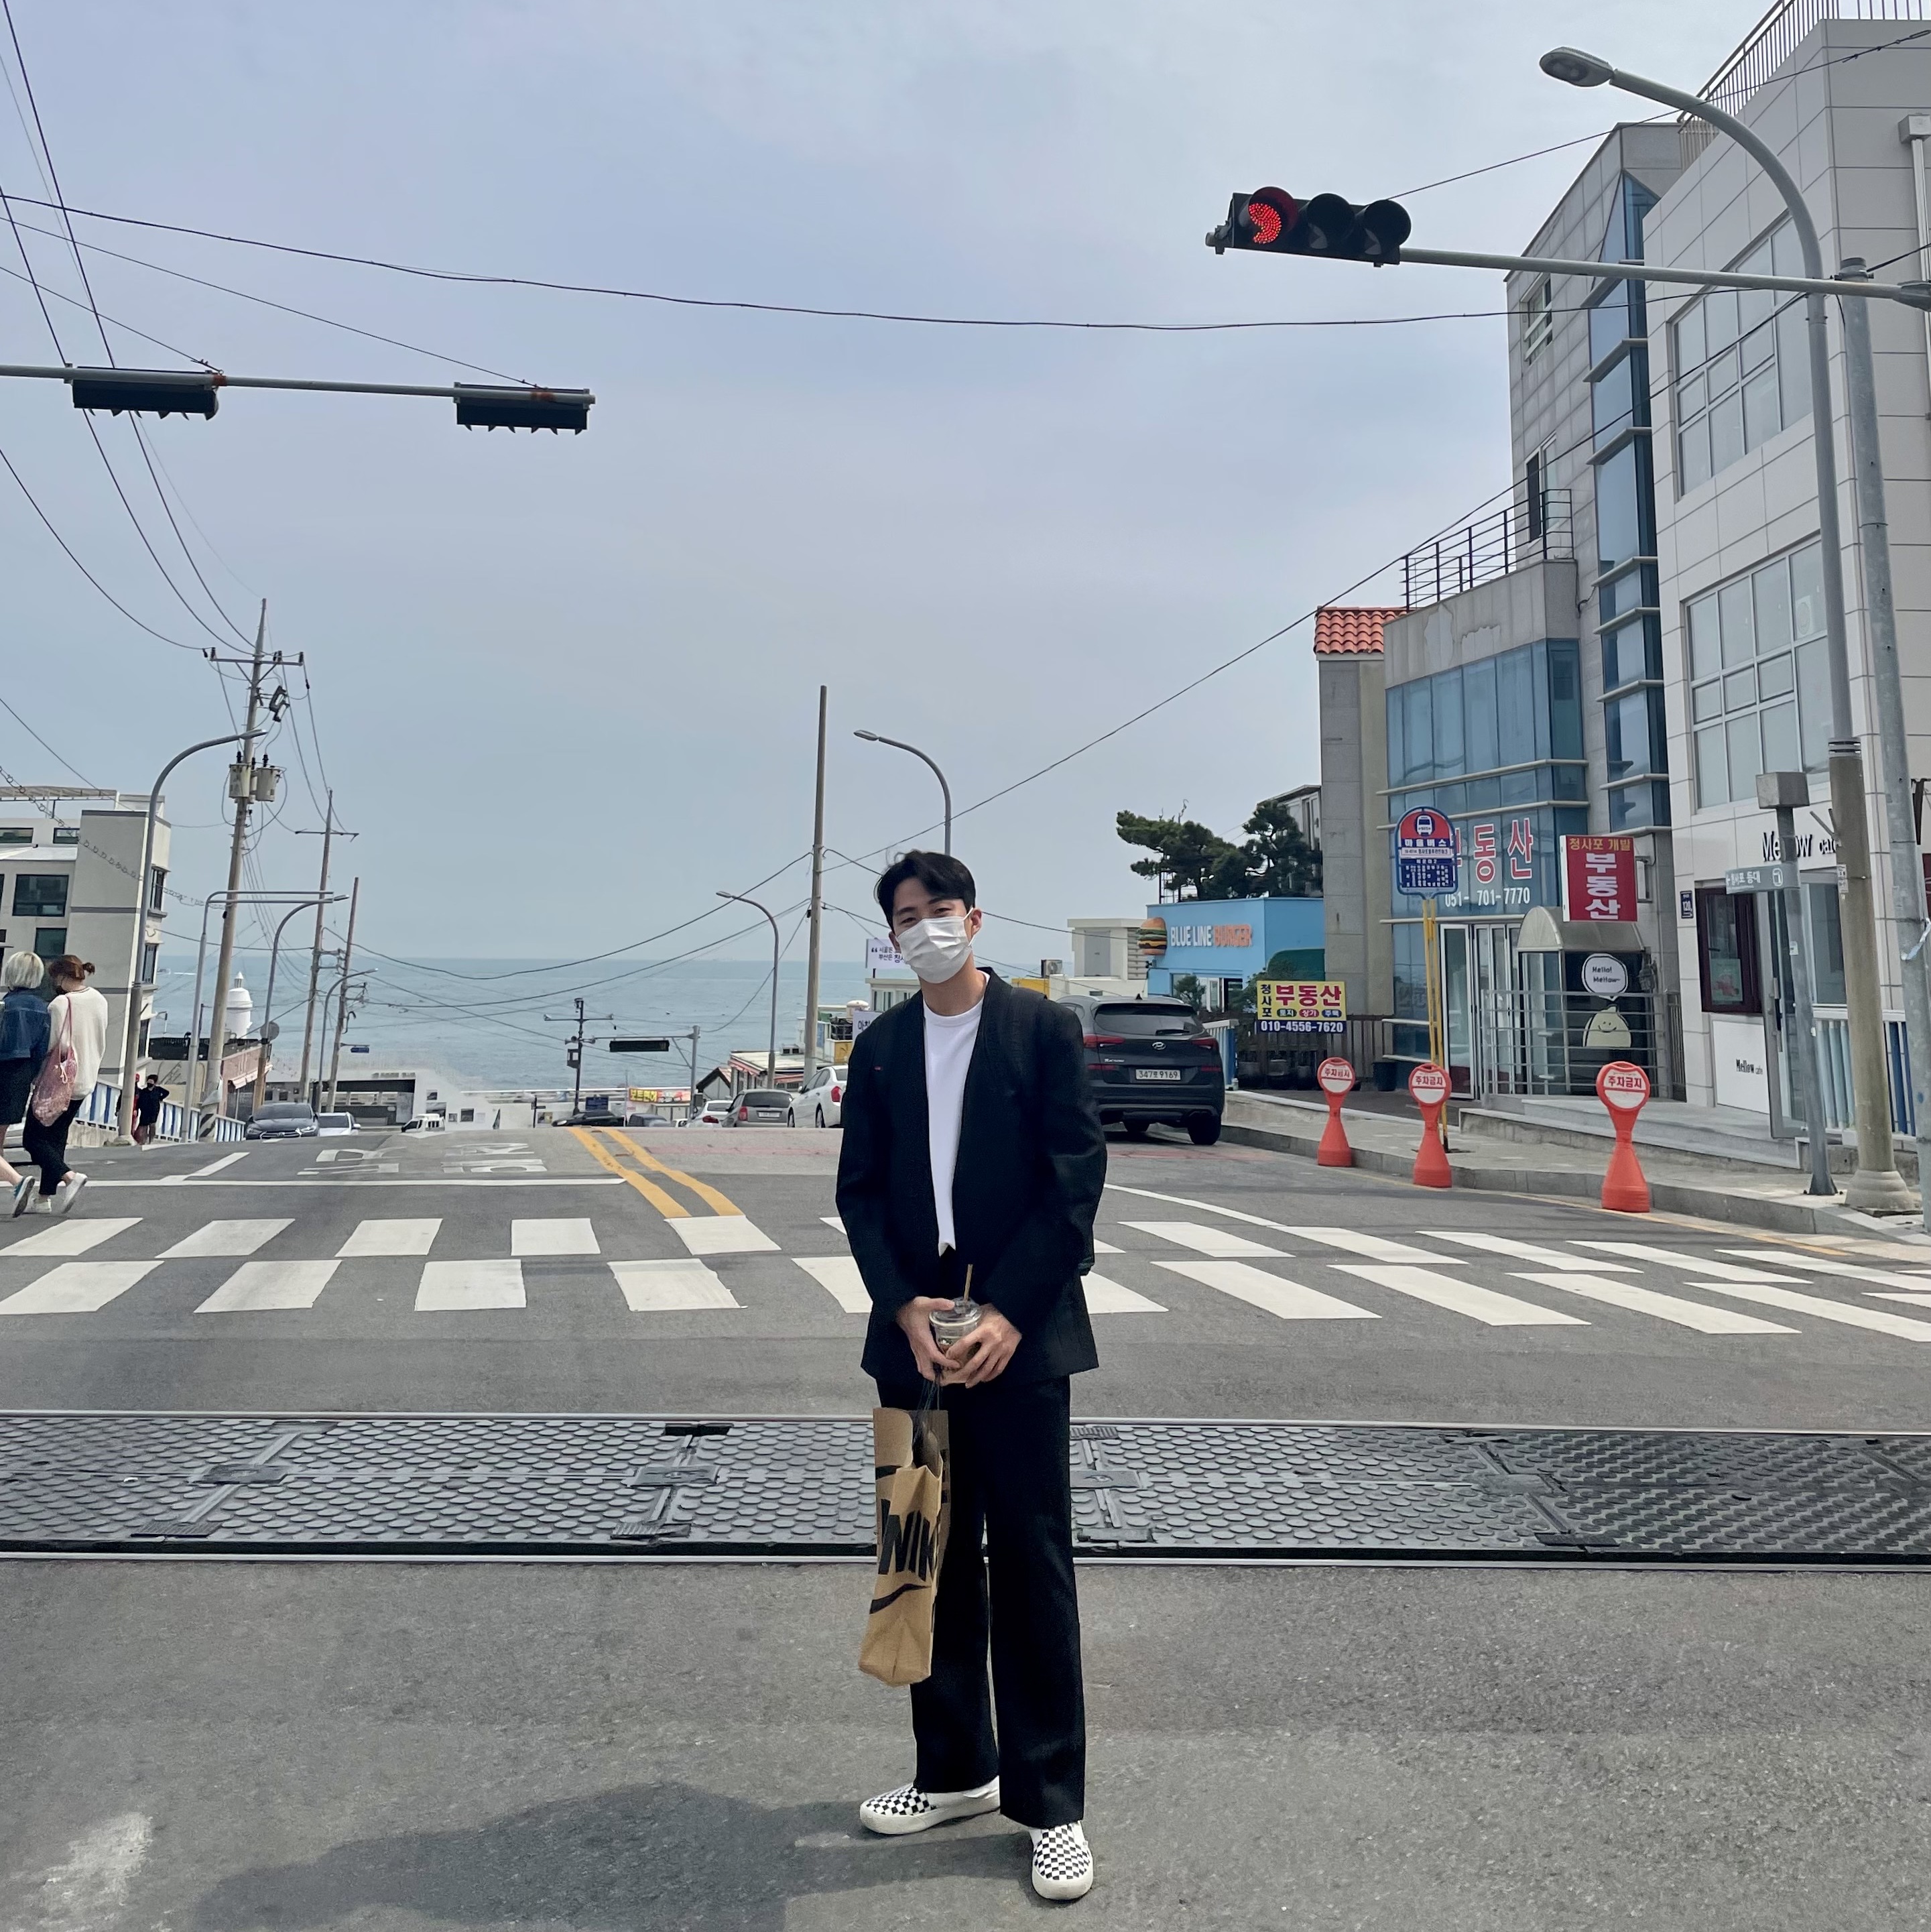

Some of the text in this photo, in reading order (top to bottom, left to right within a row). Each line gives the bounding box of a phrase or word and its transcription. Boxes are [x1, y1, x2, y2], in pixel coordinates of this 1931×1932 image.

[1455, 817, 1534, 884] 동산
[1569, 837, 1631, 851] 청사포 개발
[1762, 831, 1813, 862] Meow
[1584, 852, 1621, 920] 부동산
[1170, 924, 1253, 947] BLUE LINE BURGER
[1260, 983, 1273, 1018] 청사포
[1275, 985, 1342, 1007] 부동산
[1261, 1020, 1343, 1032] 010-4556-7620
[1416, 1075, 1443, 1086] 주차금지
[1609, 1075, 1642, 1089] 주차금지
[877, 1498, 935, 1583] NIK
